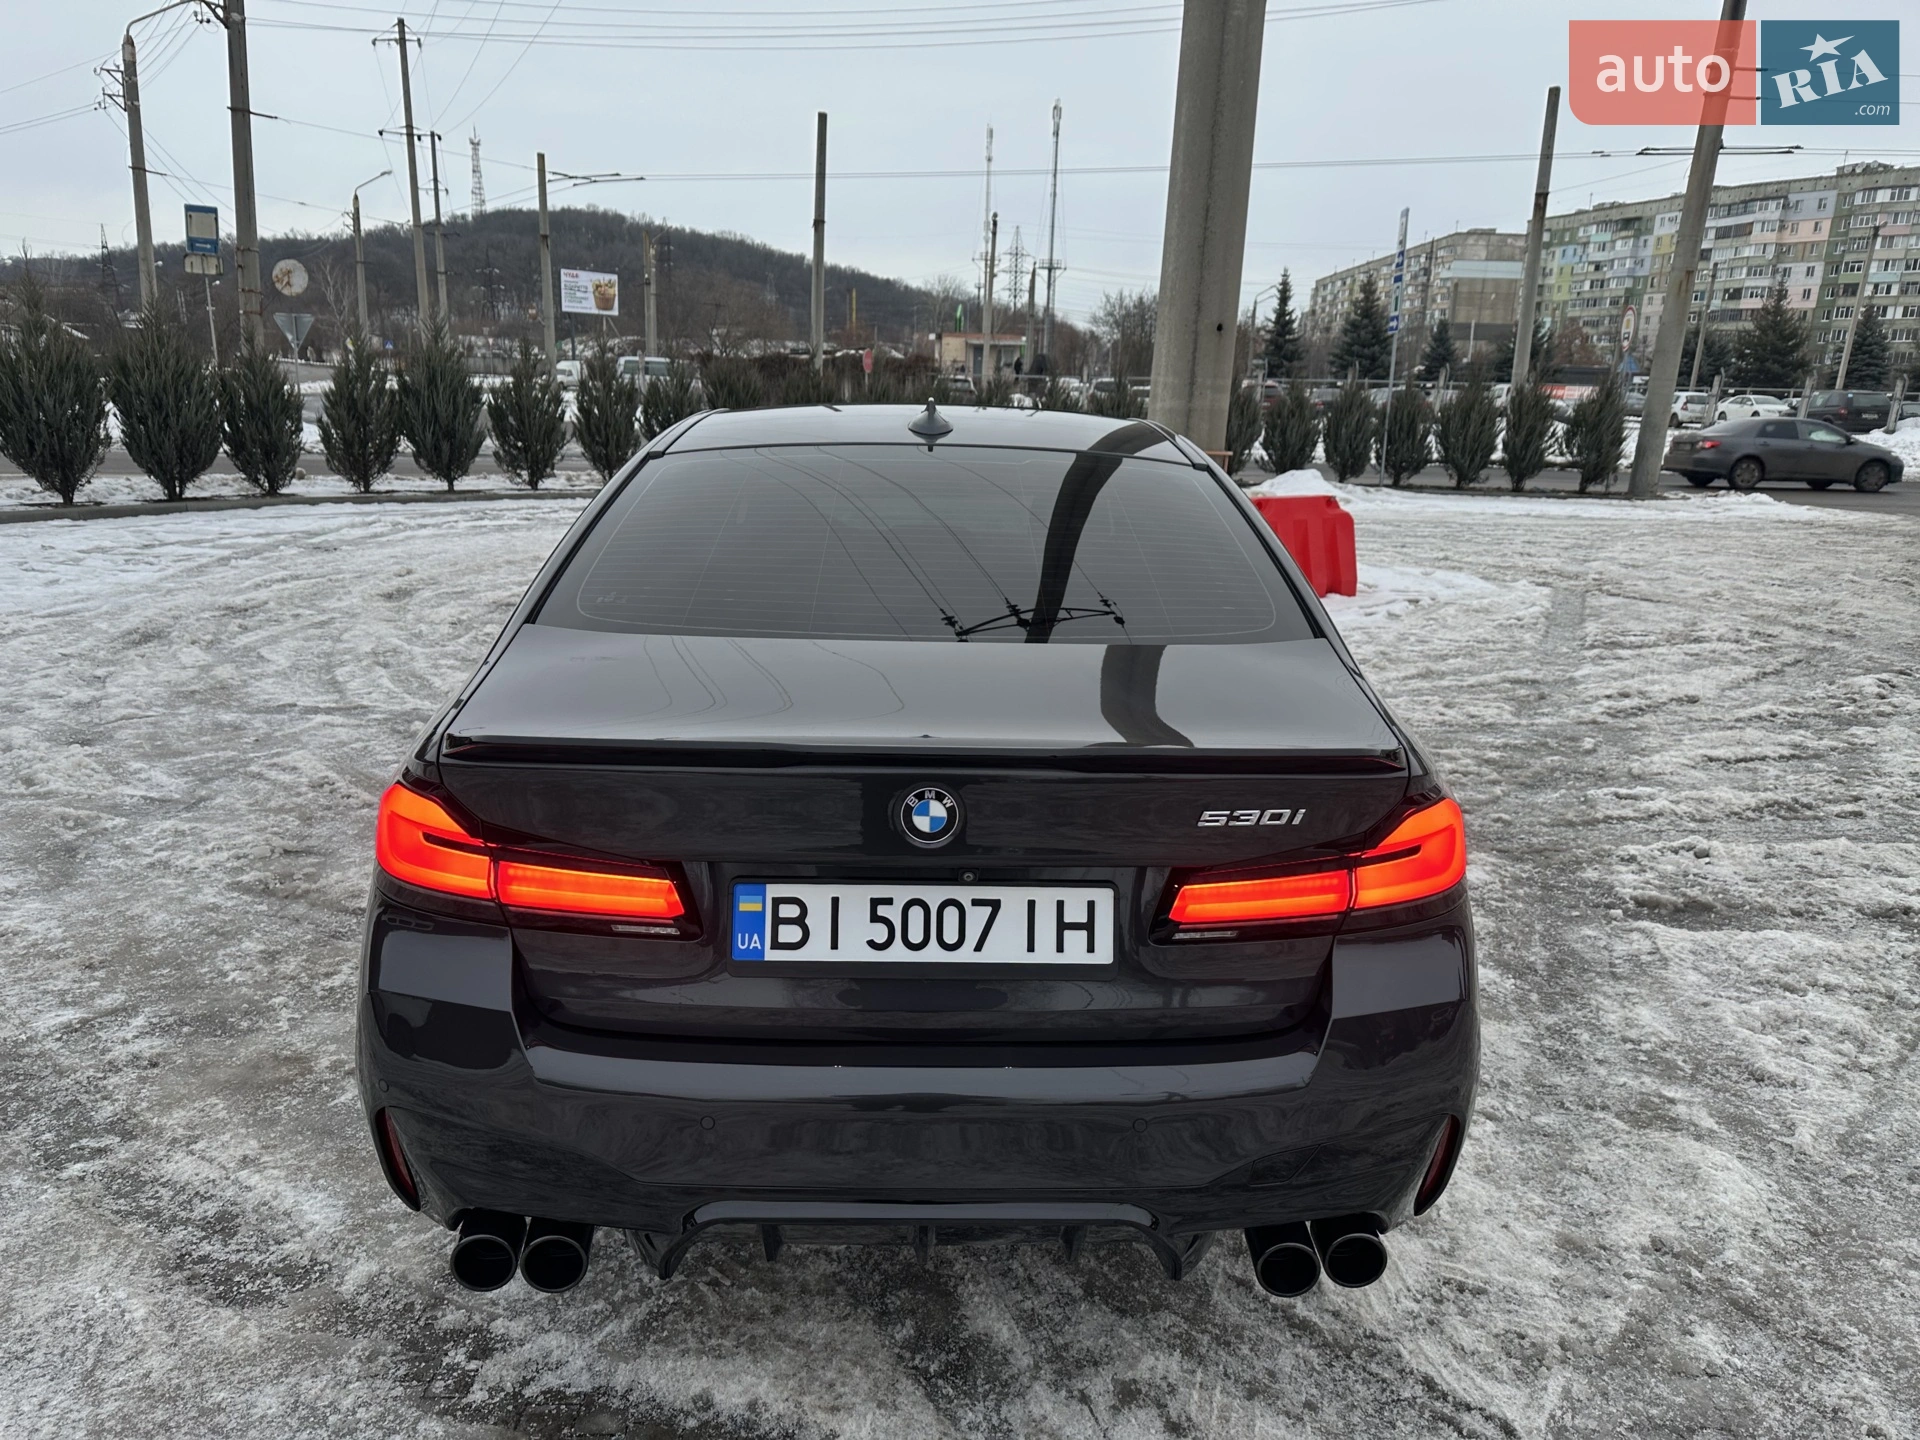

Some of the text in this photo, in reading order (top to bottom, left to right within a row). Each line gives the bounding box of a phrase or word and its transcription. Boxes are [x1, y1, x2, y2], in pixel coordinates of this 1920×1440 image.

[907, 790, 954, 808] BMW
[1197, 808, 1306, 827] 530i
[770, 896, 1096, 953] BI 5007 IH
[737, 932, 762, 950] UA
